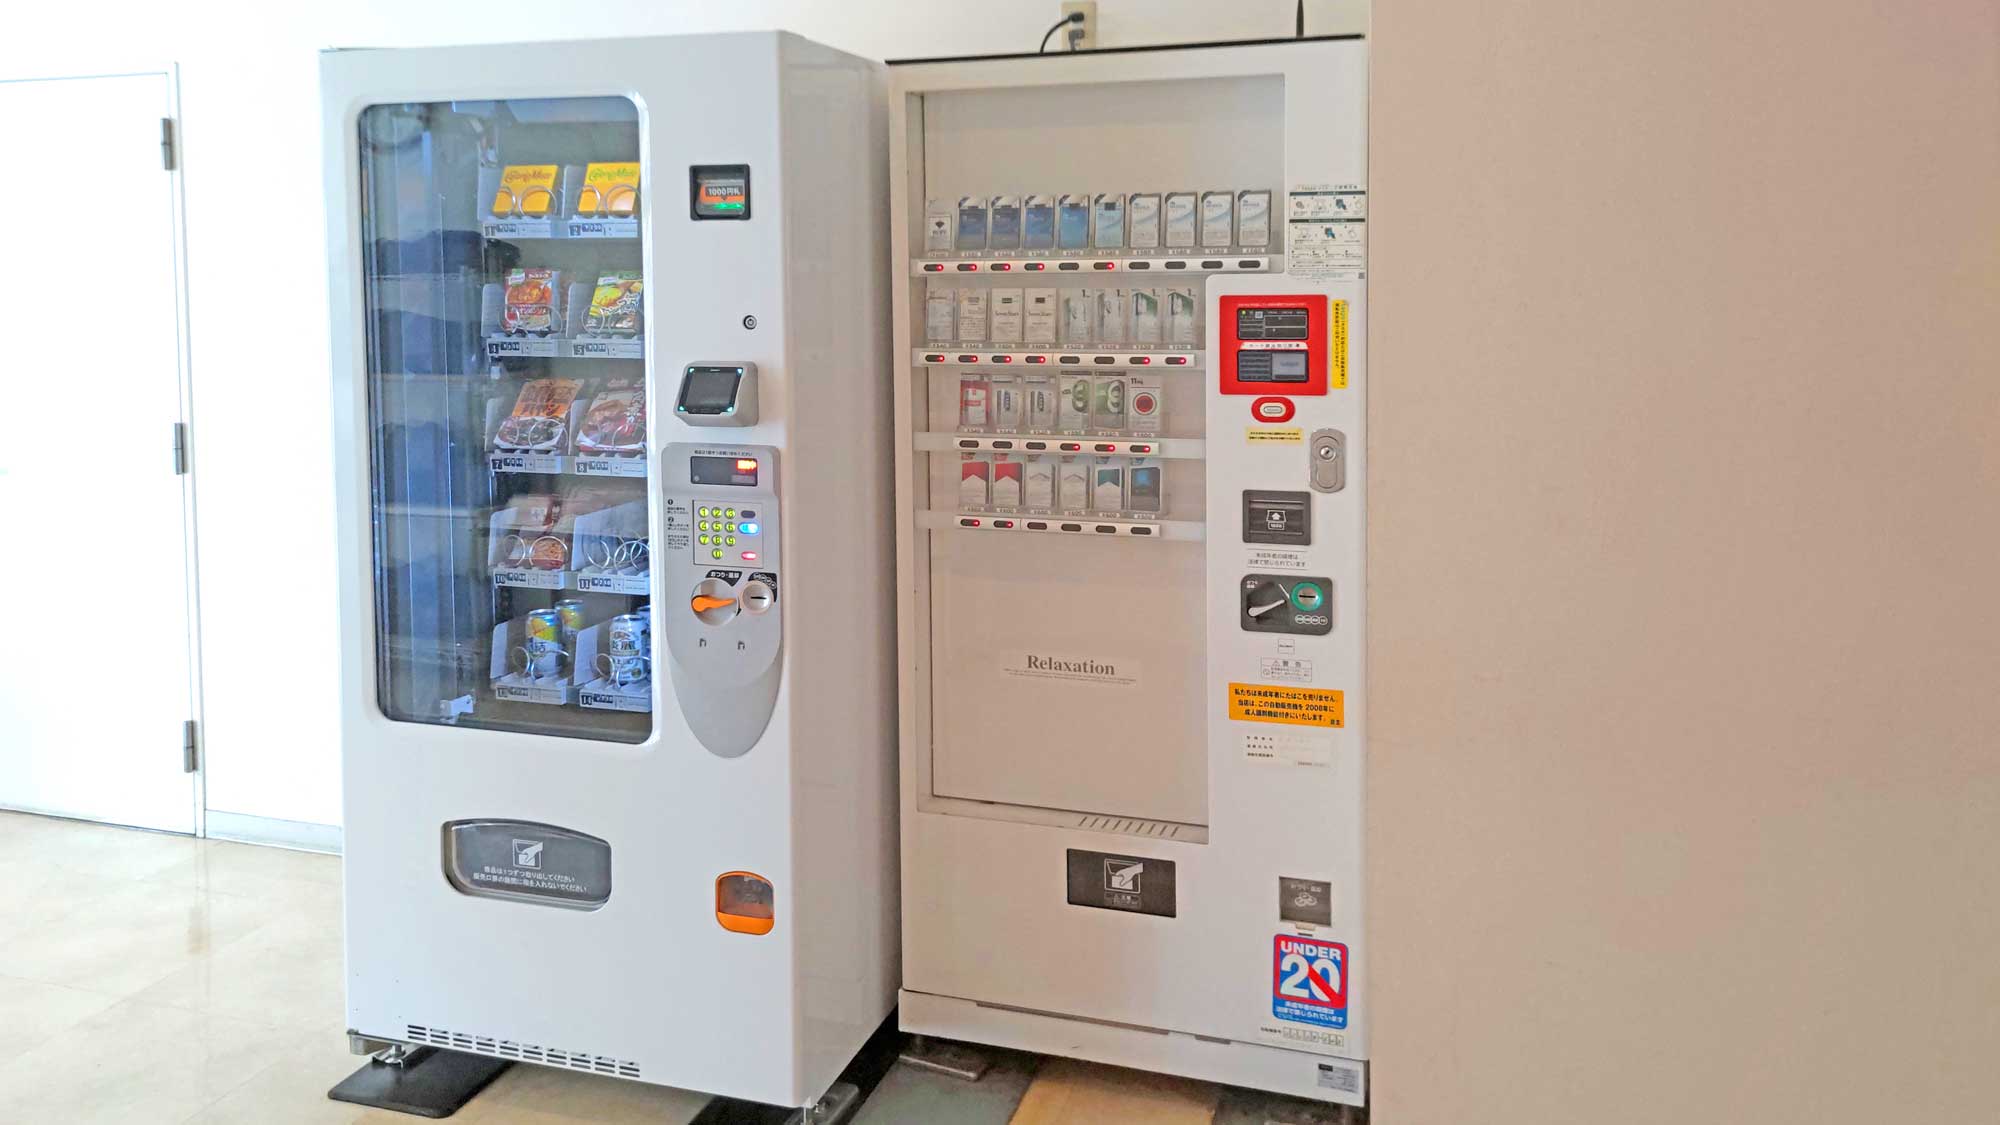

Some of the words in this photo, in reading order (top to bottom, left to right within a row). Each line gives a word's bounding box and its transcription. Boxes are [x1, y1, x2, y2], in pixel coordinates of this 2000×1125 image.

[1026, 654, 1116, 676] Relaxation
[1280, 940, 1342, 961] UNDER
[1280, 953, 1341, 1002] 20
